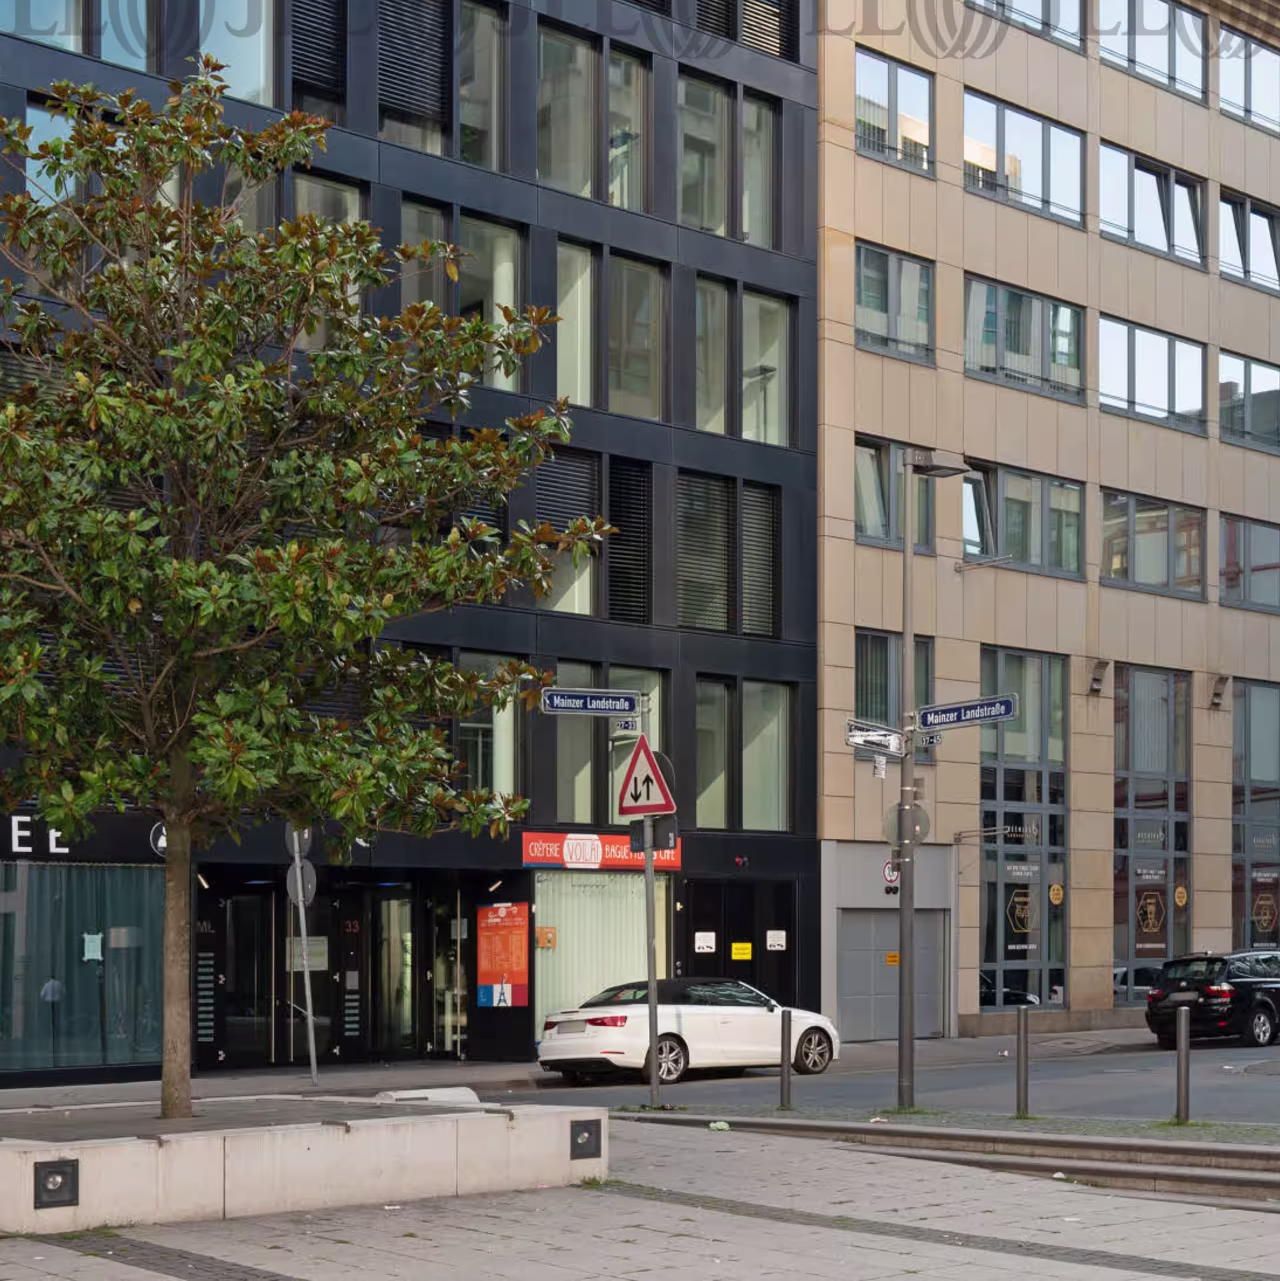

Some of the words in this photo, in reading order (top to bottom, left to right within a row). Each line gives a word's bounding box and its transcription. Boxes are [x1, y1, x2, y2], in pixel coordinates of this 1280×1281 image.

[553, 695, 584, 708] Mainzer
[587, 697, 629, 710] Landstraße
[927, 710, 958, 725] Mainzer
[961, 702, 1005, 720] Landstraße
[344, 921, 360, 933] 33
